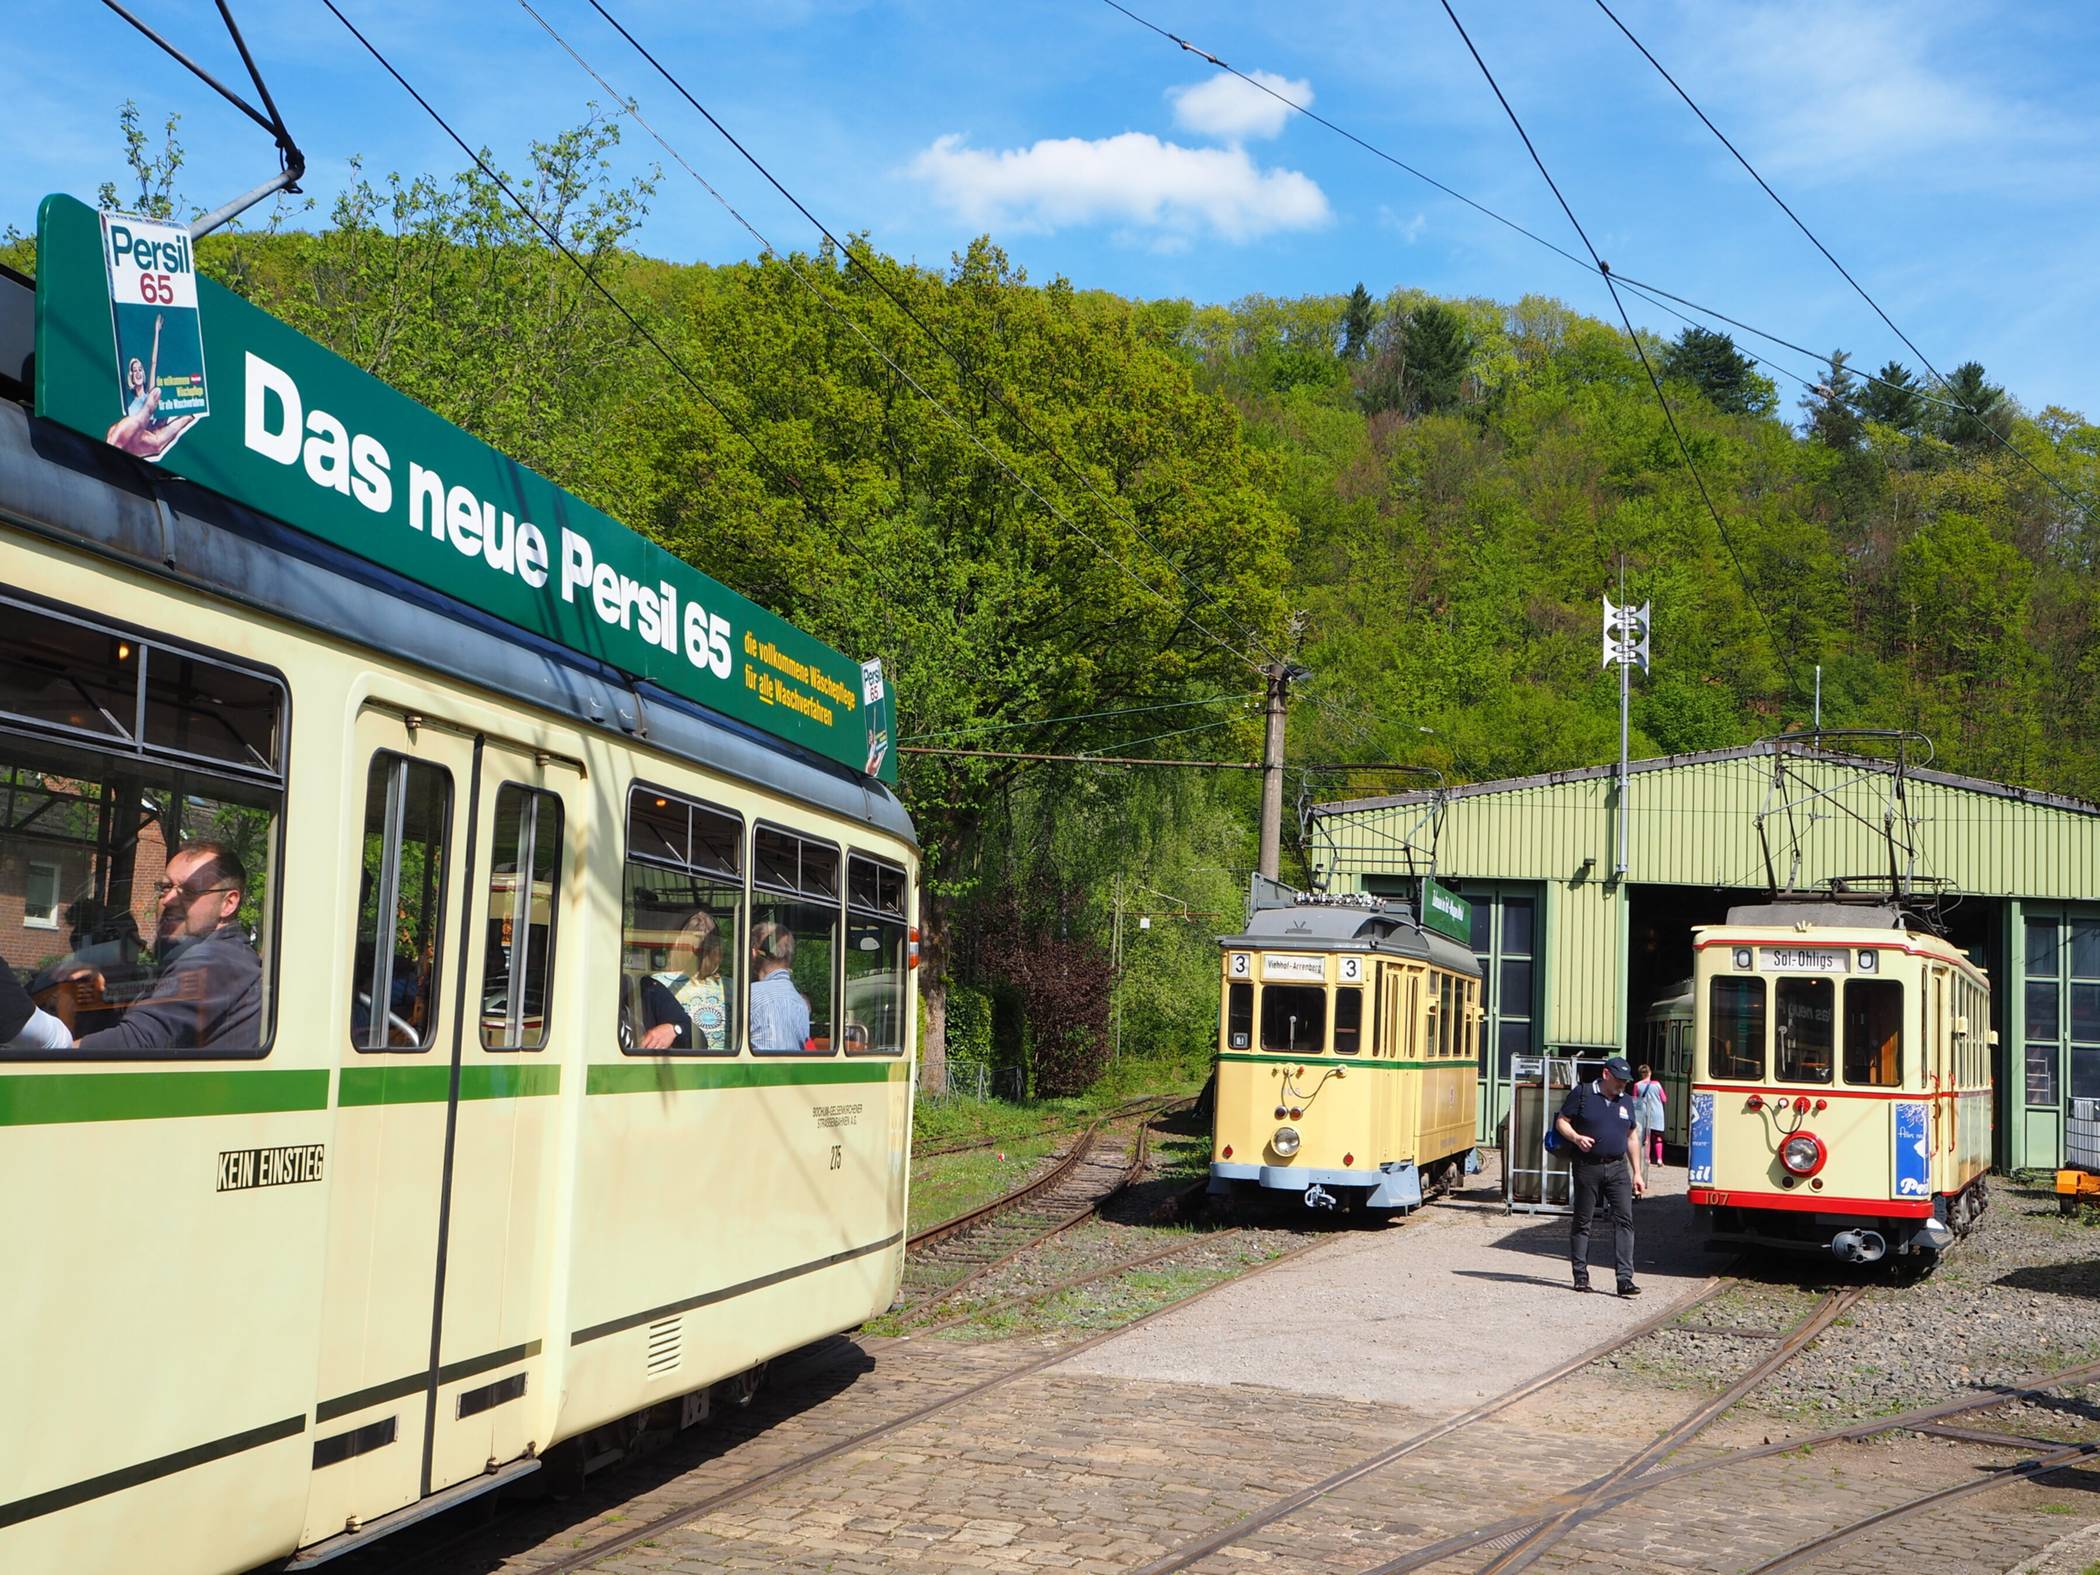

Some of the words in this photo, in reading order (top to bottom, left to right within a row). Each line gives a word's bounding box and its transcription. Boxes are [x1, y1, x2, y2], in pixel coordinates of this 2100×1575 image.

[110, 224, 190, 273] Persil
[140, 272, 174, 304] 65
[244, 350, 393, 513] Das
[409, 461, 549, 588] neue
[561, 526, 678, 655] Persil
[684, 601, 732, 680] 65
[744, 630, 757, 657] die
[758, 642, 809, 684] vollkommene
[809, 665, 856, 711] Wäschepflege
[744, 663, 757, 691] für
[758, 673, 774, 698] alle
[774, 678, 833, 727] Waschverfahren
[1235, 955, 1246, 973] 3
[1346, 959, 1357, 978] 3
[217, 1151, 256, 1190] KEIN
[258, 1145, 324, 1186] EINSTIEG
[830, 1144, 842, 1170] 275
[1705, 1191, 1729, 1206] 107
